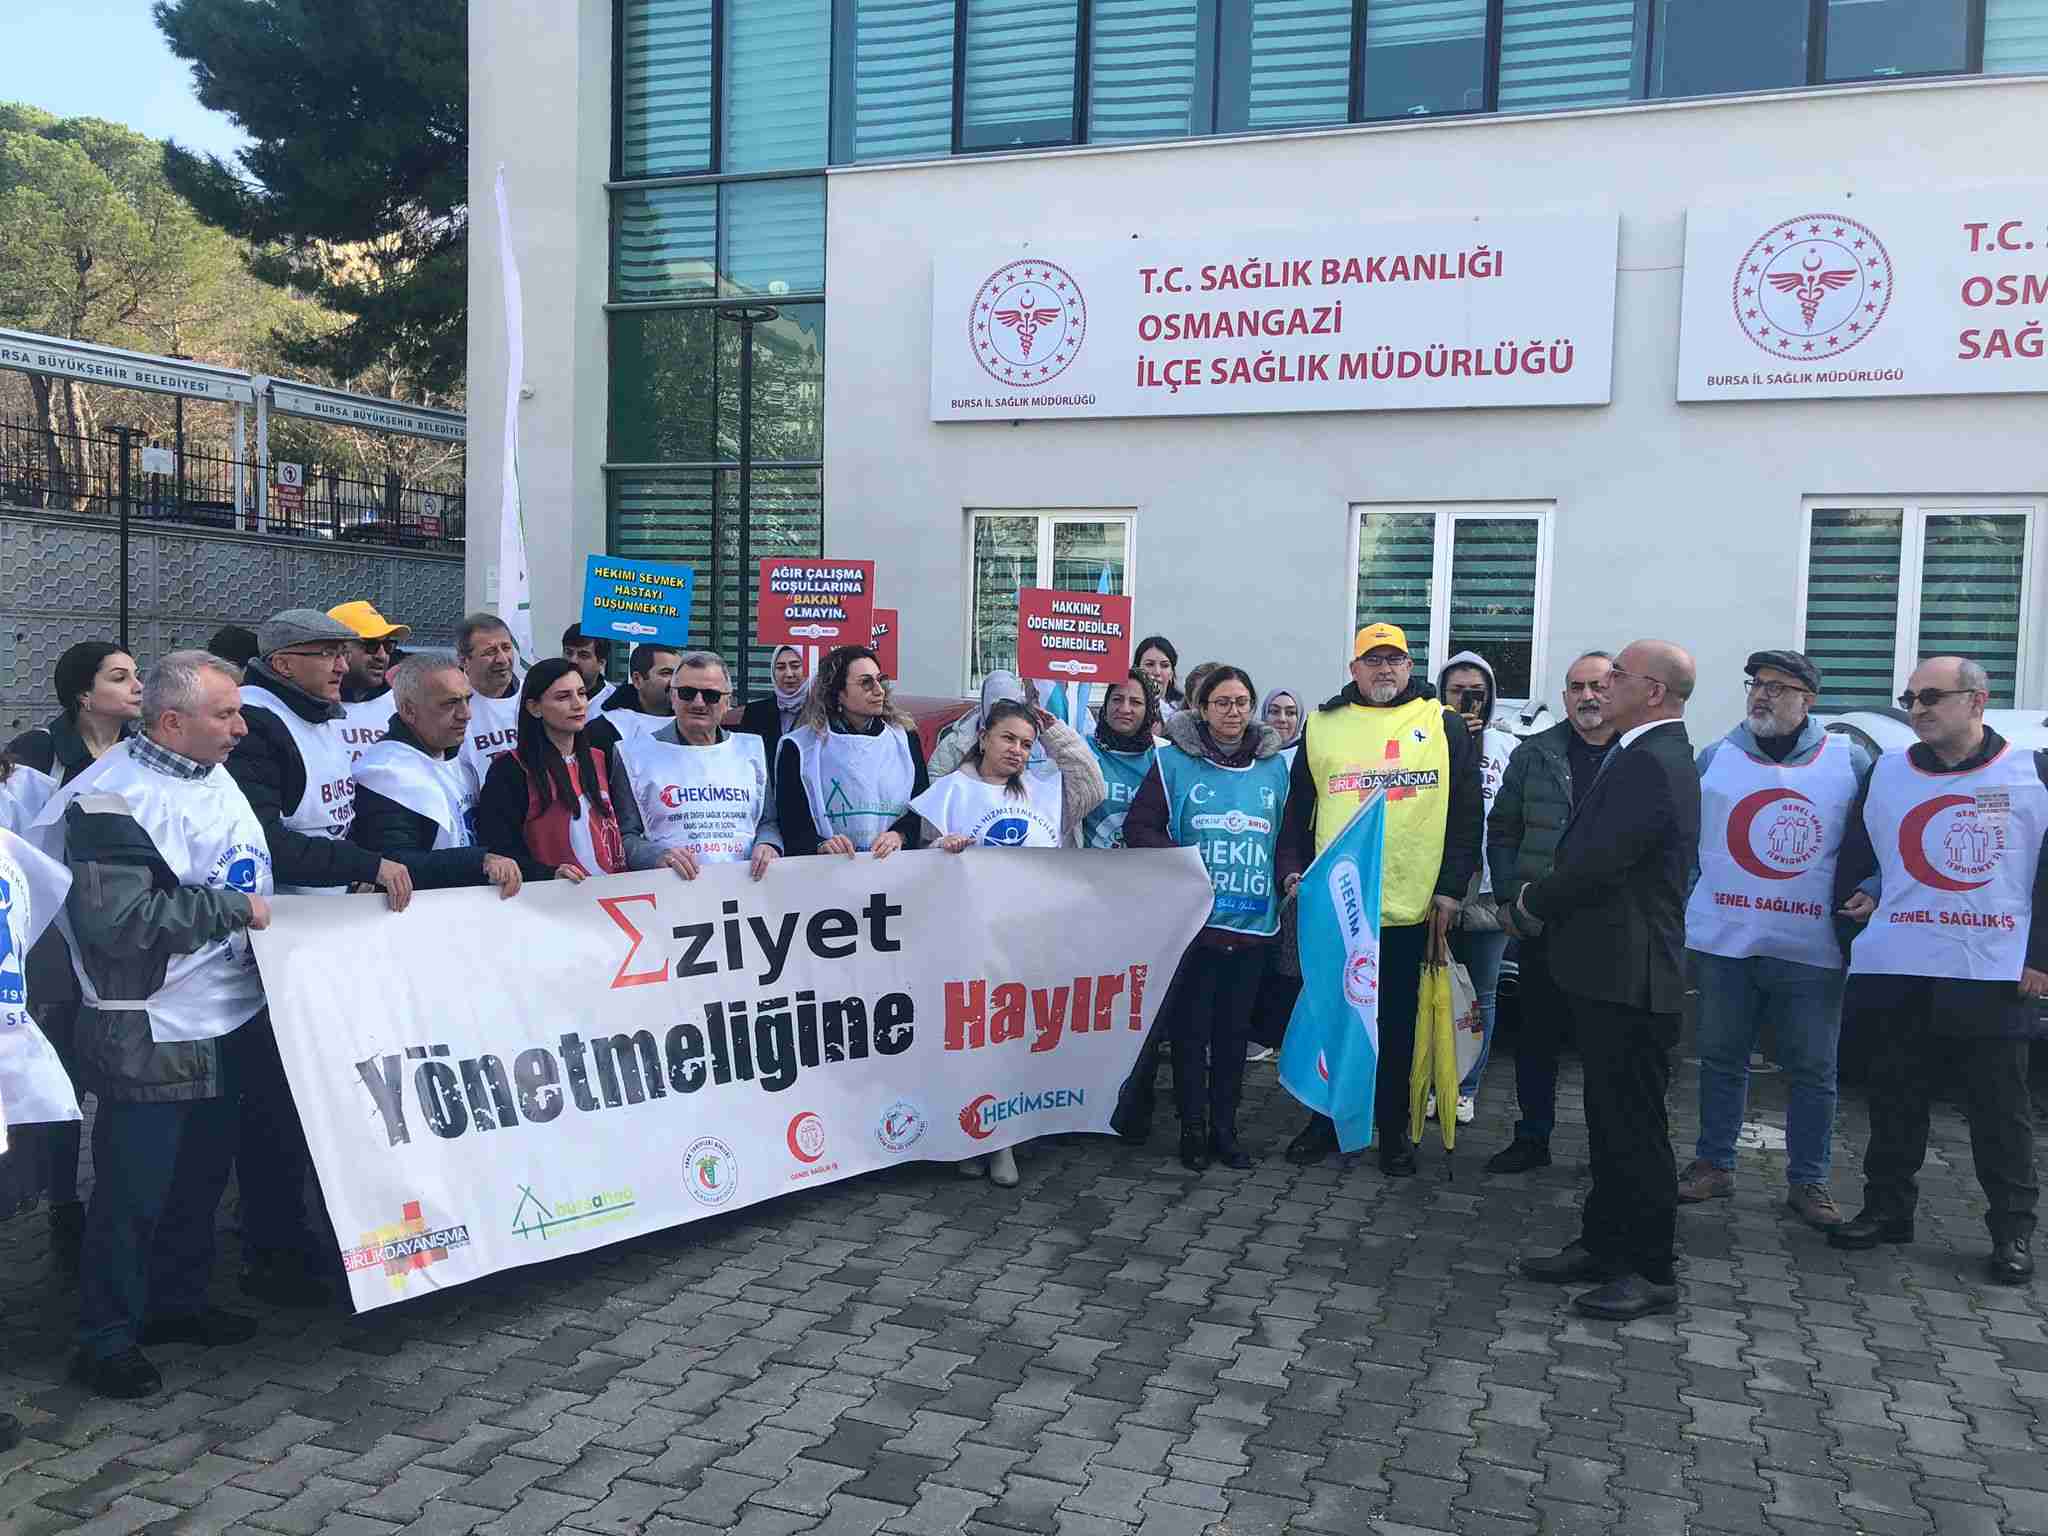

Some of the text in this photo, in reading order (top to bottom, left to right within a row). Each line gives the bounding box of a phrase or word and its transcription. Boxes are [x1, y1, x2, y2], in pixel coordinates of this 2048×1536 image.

[1963, 221, 2034, 251] T.C.
[1139, 244, 1503, 294] T.C. SAĞLIK BAKANLIĞI
[1961, 274, 2048, 307] OSM
[1138, 300, 1343, 342] OSMANGAZİ
[1958, 320, 2044, 360] SAĞ
[1, 351, 209, 392] RSA BÜYÜKŞEHİR BELEDİYESİ
[1136, 338, 1574, 394] İLÇE SAĞLIK MÜDÜRLÜĞÜ
[1707, 366, 1904, 387] BURSA İL SAĞLIK MÜDÜRLÜĞÜ
[951, 393, 1096, 409] BURSA İL SAĞLIK MÜDÜRLÜĞÜ
[314, 402, 464, 437] BURSA BÜYÜKŞEHİR BELEDİYES
[639, 572, 685, 588] SEVMEK
[771, 566, 864, 581] AĞIR ÇALIŞMA
[615, 584, 663, 600] HASTAYI
[771, 580, 862, 593] KOŞULLARINA
[784, 607, 846, 619] OLMAYIN.
[1052, 599, 1101, 616] HAKKINIZ
[1027, 614, 1122, 637] ÖDENMEZ DEDİLER,
[1041, 633, 1108, 652] ÖDEMEDİLER.
[677, 784, 750, 802] HEKİMSEN
[1338, 873, 1361, 938] HEKİM
[1890, 910, 1935, 924] GENEL
[354, 963, 1149, 1148] Yönetmeliğine Hayır!
[984, 1088, 1085, 1125] HEKİMSEN
